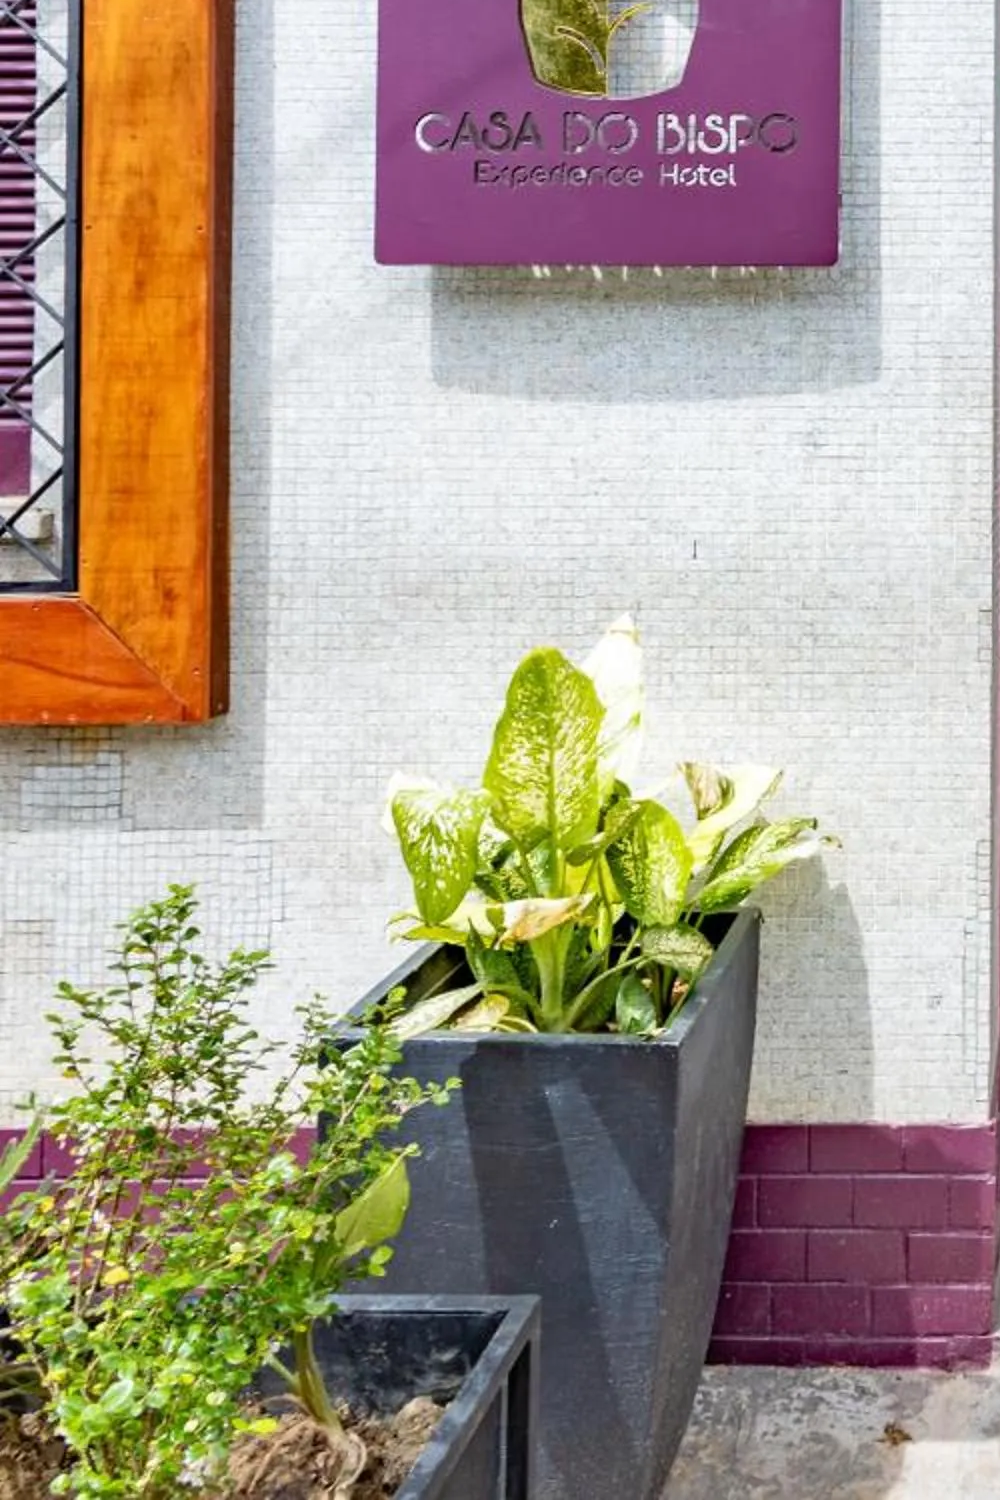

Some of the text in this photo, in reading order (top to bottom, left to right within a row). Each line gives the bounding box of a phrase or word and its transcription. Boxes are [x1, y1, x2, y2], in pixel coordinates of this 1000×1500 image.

[415, 111, 798, 155] CASA DO BISPO
[472, 160, 737, 188] Experience Hotel
